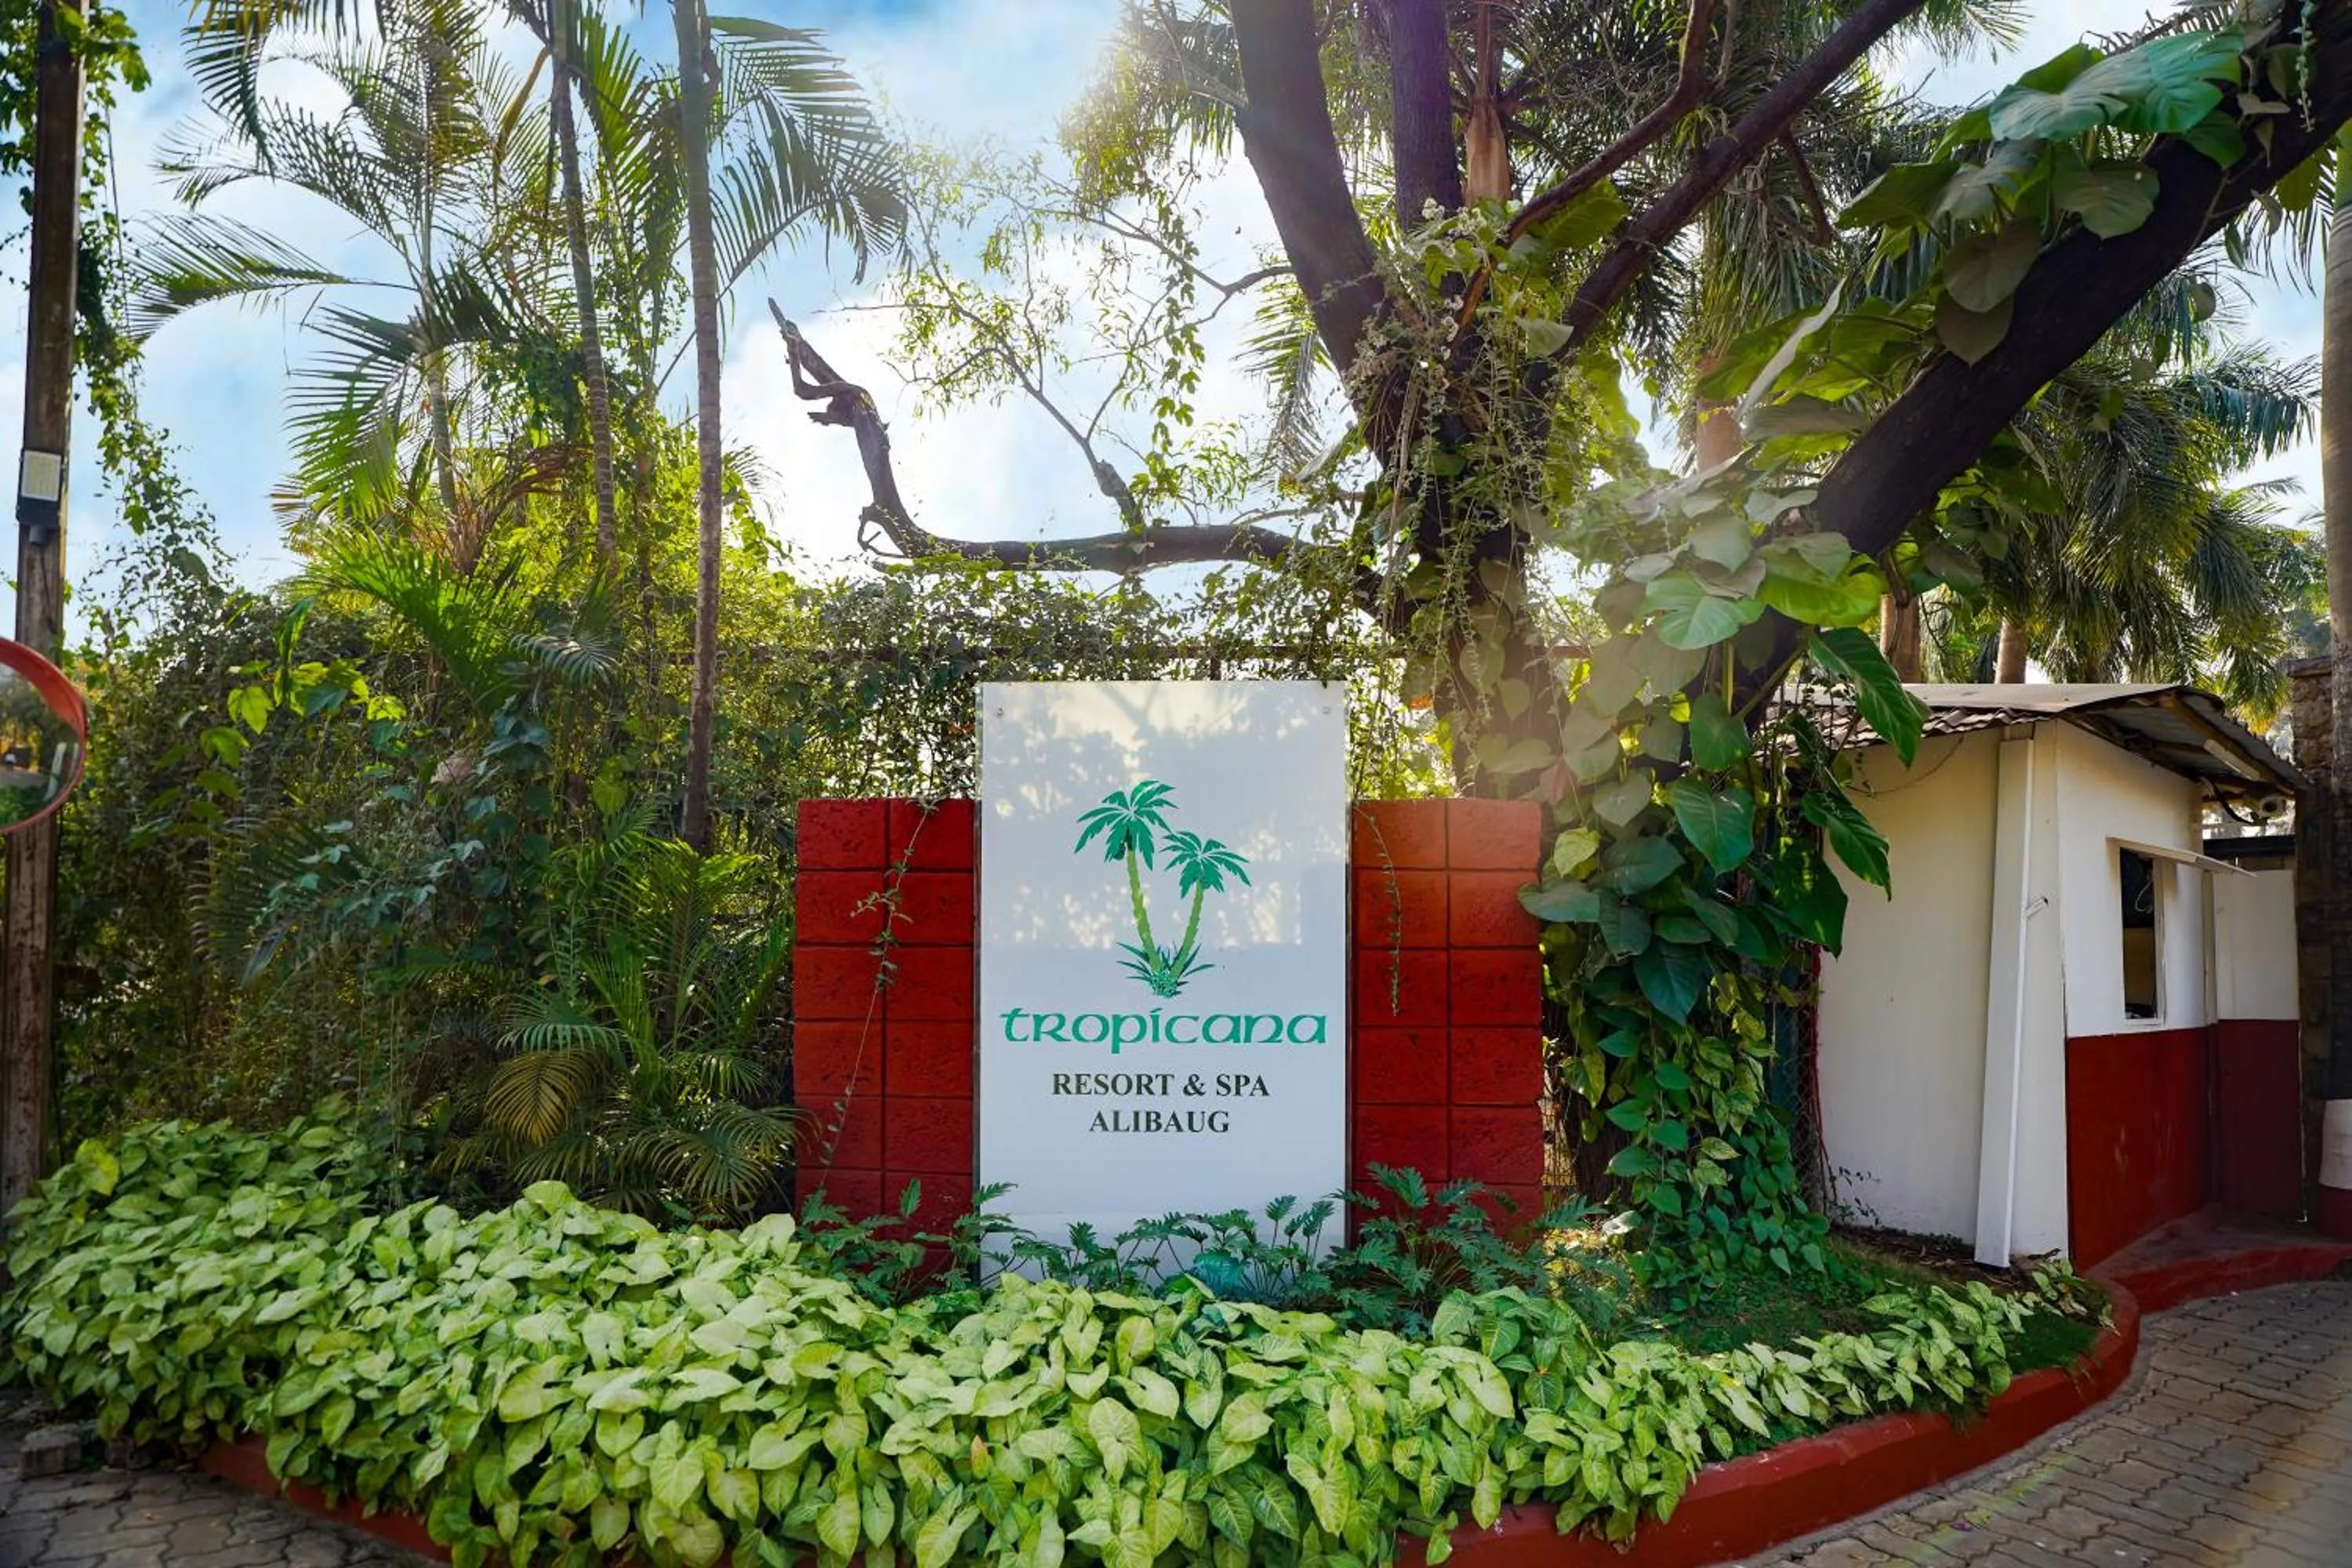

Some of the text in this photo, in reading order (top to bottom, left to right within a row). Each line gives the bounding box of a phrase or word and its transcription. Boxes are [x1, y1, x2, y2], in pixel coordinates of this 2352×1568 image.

[1000, 1007, 1327, 1054] tropicana
[1053, 1074, 1269, 1096] RESORT & SPA
[1090, 1110, 1229, 1133] ALIBAUG
